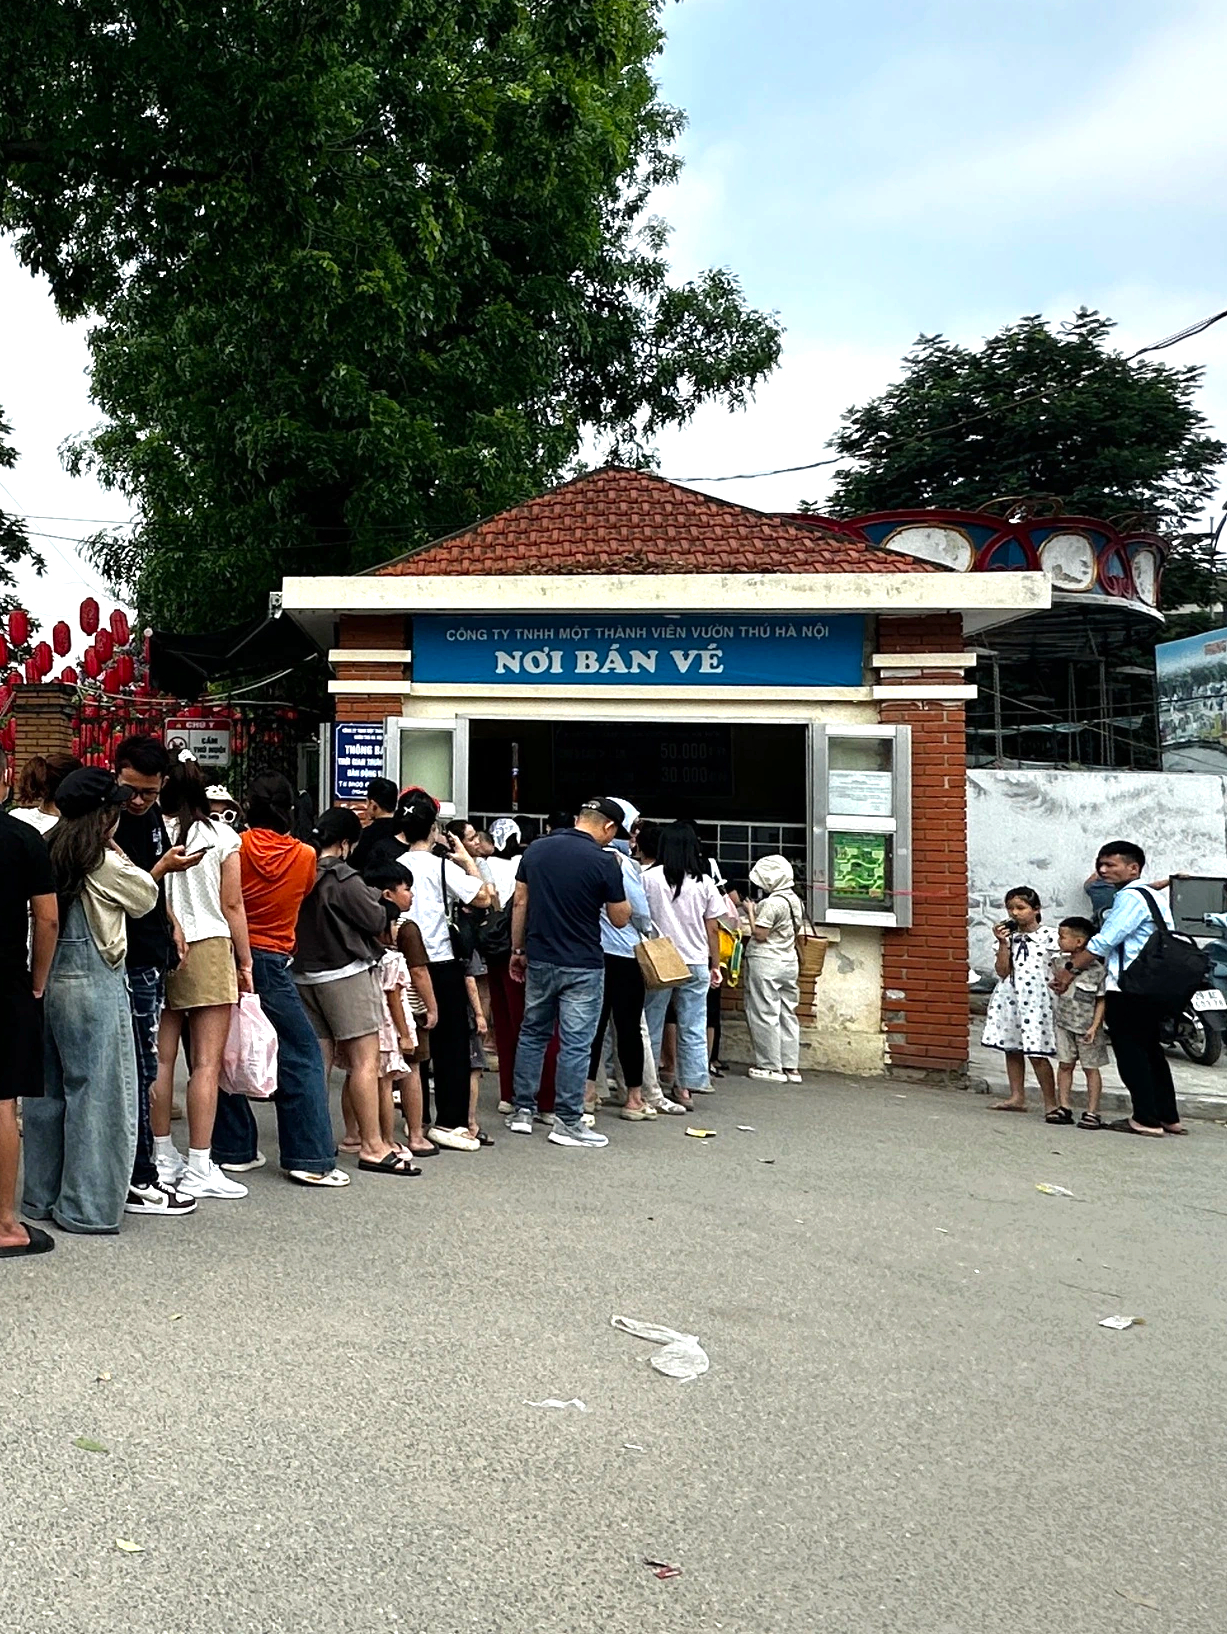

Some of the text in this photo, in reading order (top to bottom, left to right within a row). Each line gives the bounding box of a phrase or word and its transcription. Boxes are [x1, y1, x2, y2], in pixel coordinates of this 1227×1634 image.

[446, 622, 829, 642] CÔNG TY TNHH MỘT THÀNH VIÊN VƯỜN THÚ HÀ NỘI
[494, 643, 724, 674] NƠI BÁN VÉ
[344, 744, 373, 754] THÔNG
[660, 742, 708, 759] 50.000
